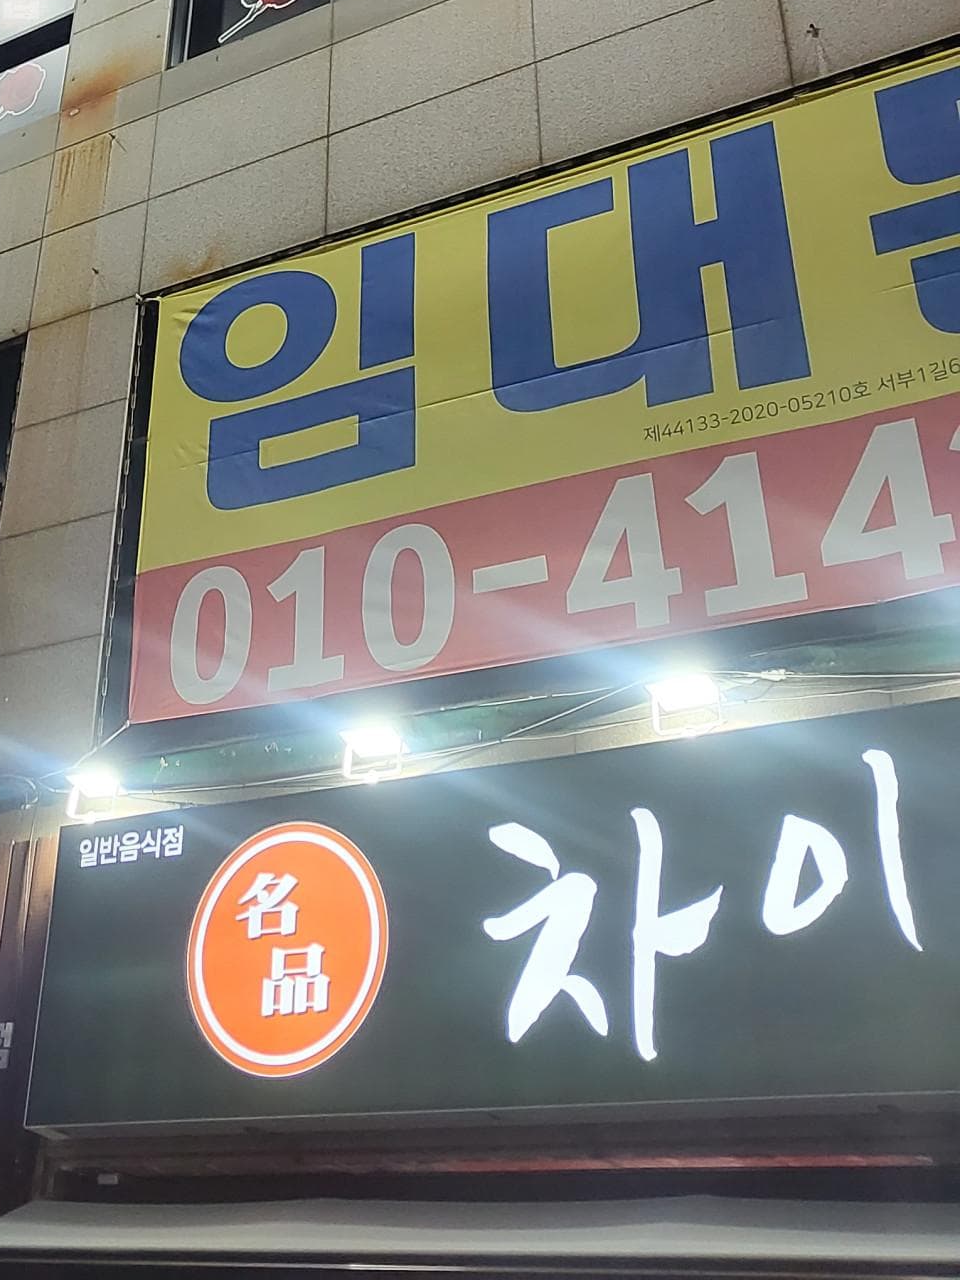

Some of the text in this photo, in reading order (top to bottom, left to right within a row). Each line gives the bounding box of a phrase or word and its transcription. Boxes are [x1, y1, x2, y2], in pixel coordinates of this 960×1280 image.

[642, 379, 873, 444] 제44133-2020-05210호
[79, 824, 184, 868] 일반음식점
[235, 872, 330, 1017] 名品
